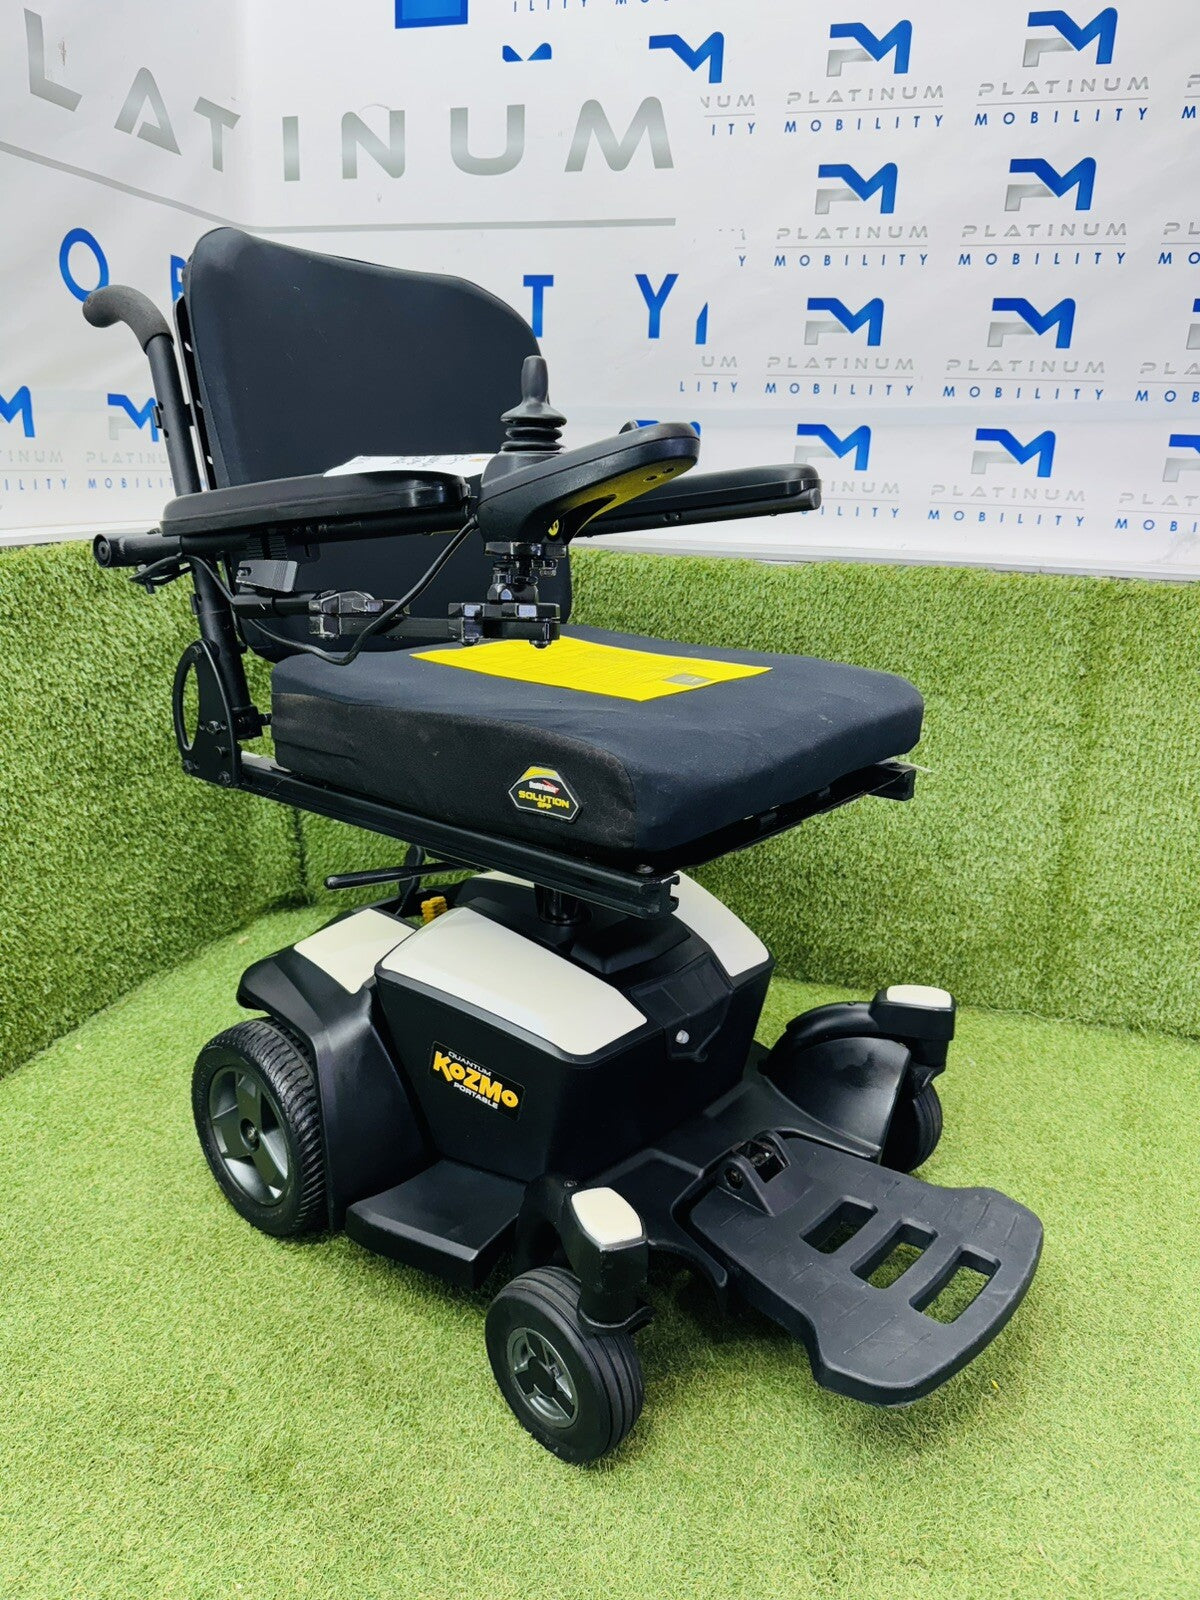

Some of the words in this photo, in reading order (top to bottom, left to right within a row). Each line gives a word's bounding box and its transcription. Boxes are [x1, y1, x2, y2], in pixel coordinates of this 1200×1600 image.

[786, 84, 944, 105] PLATINUM
[977, 76, 1149, 97] PLATINUM
[784, 114, 944, 133] MOBILITY
[974, 107, 1148, 126] MOBILITY
[776, 225, 928, 240] PLATINUM
[961, 222, 1127, 238] PLATINUM
[774, 254, 928, 267] MOBILITY
[958, 252, 1126, 266] MOBILITY
[766, 356, 914, 371] PLATINUM
[946, 358, 1106, 374] PLATINUM
[764, 382, 914, 396] MOBILITY
[943, 385, 1104, 401] MOBILITY
[930, 484, 1086, 502] PLATINUM
[928, 509, 1084, 527] MOBILITY
[517, 790, 570, 809] SOLUTION
[447, 1051, 492, 1077] QUANTUM
[453, 1082, 499, 1110] PORTABLE
